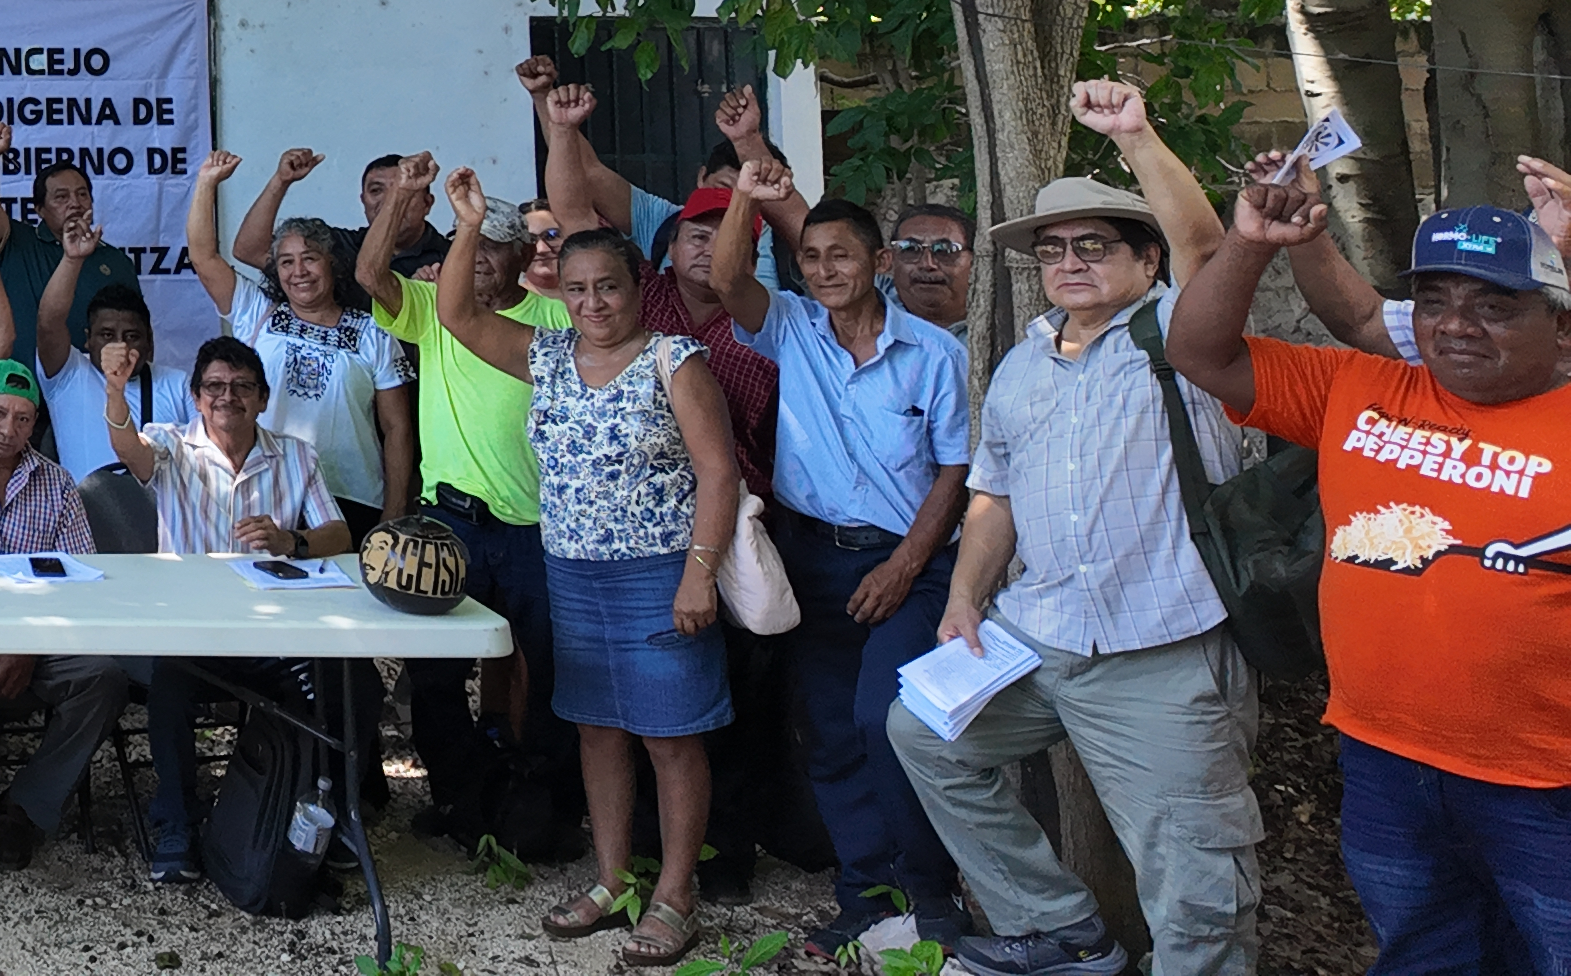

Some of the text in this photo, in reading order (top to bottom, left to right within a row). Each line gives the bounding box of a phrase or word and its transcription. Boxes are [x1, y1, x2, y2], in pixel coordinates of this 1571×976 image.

[133, 97, 175, 126] DE
[147, 147, 188, 176] DE
[119, 246, 198, 275] TZA
[1356, 410, 1553, 478] CHEESY TOP
[1342, 429, 1533, 499] PEPPERONI
